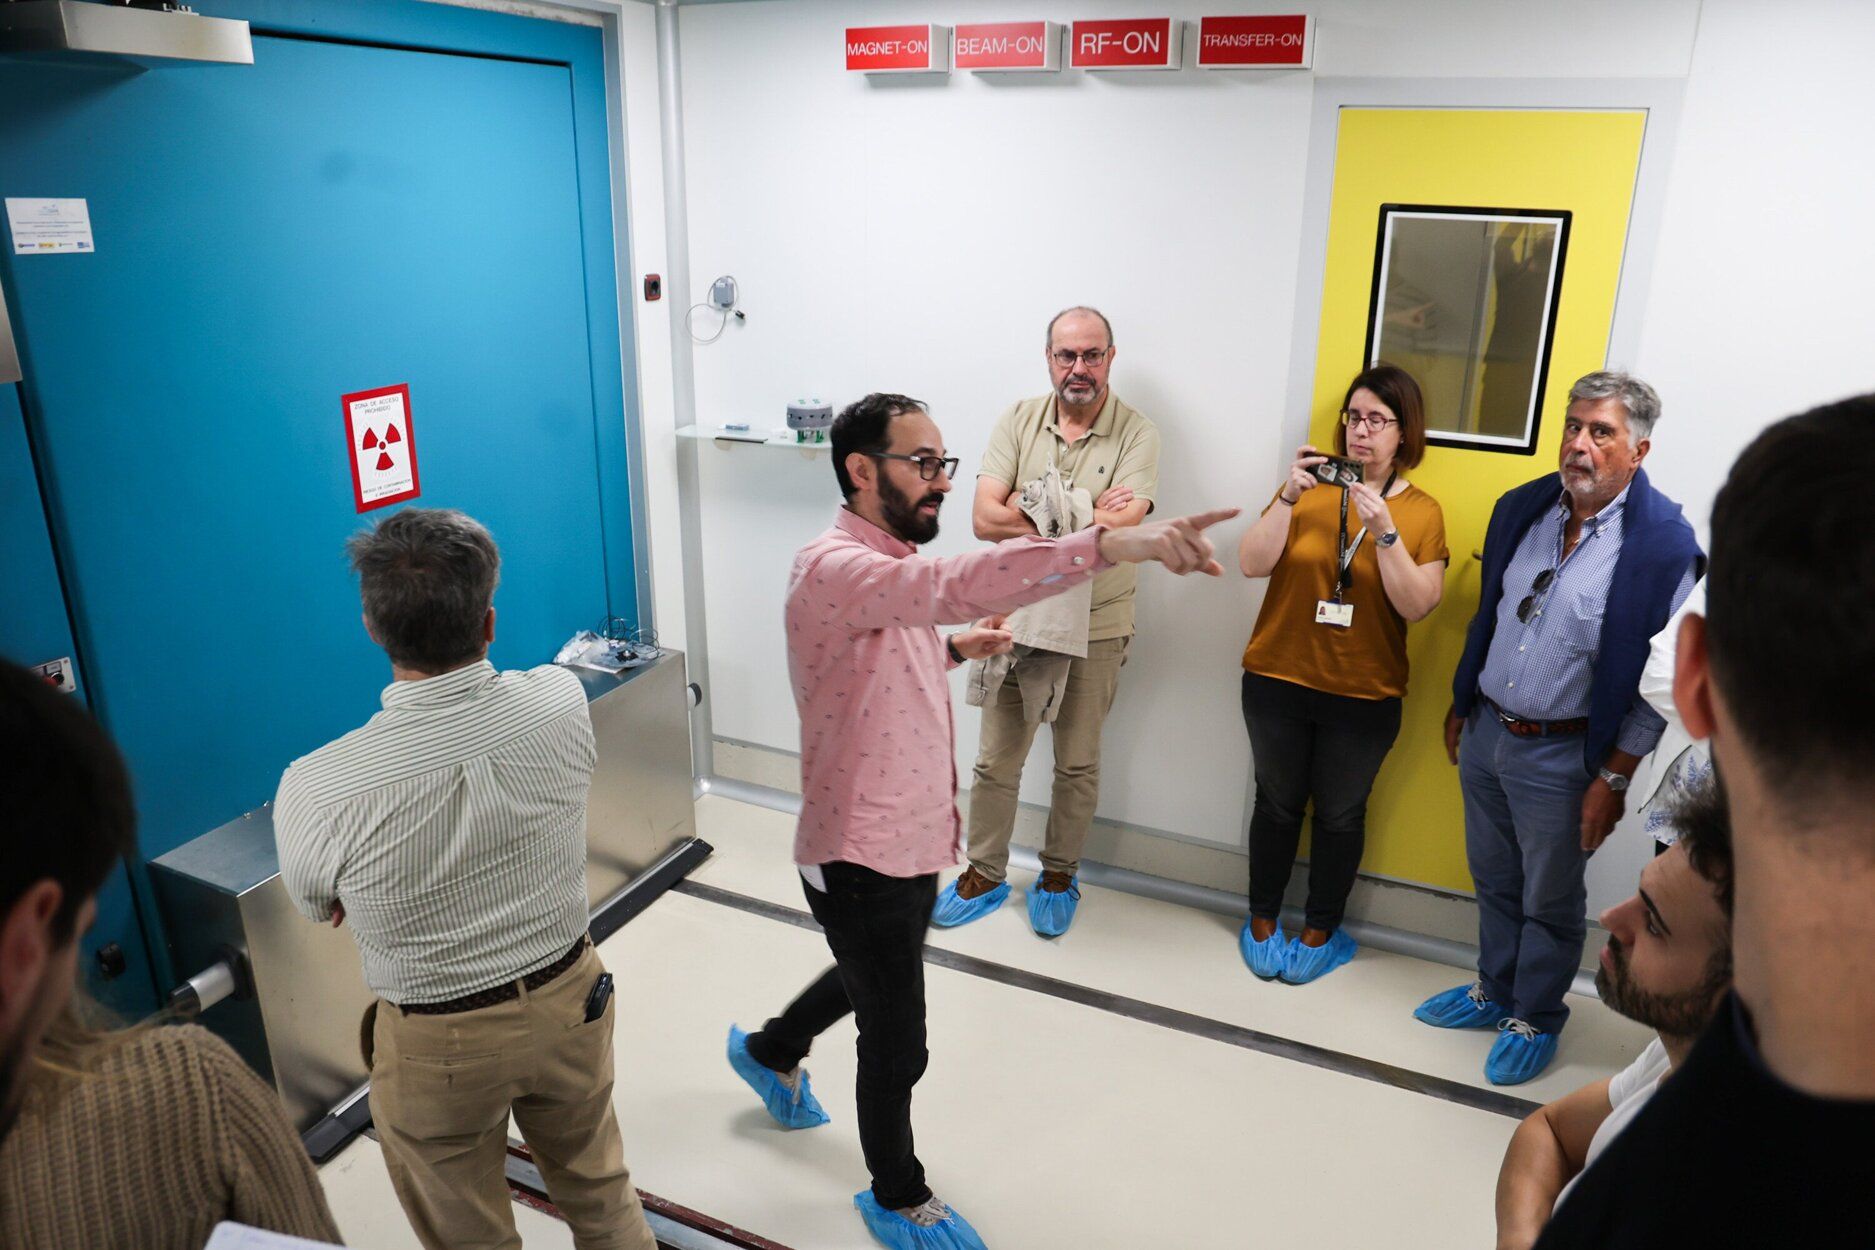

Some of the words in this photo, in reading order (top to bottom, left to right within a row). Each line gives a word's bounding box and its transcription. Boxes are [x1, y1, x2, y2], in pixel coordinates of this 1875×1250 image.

[847, 39, 928, 56] MAGNET-ON
[956, 36, 1043, 55] BEAM-ON
[1080, 31, 1160, 55] RF-ON
[1203, 33, 1303, 47] TRANSFER-ON
[354, 402, 368, 410] ZONA
[379, 396, 399, 405] ACCESO
